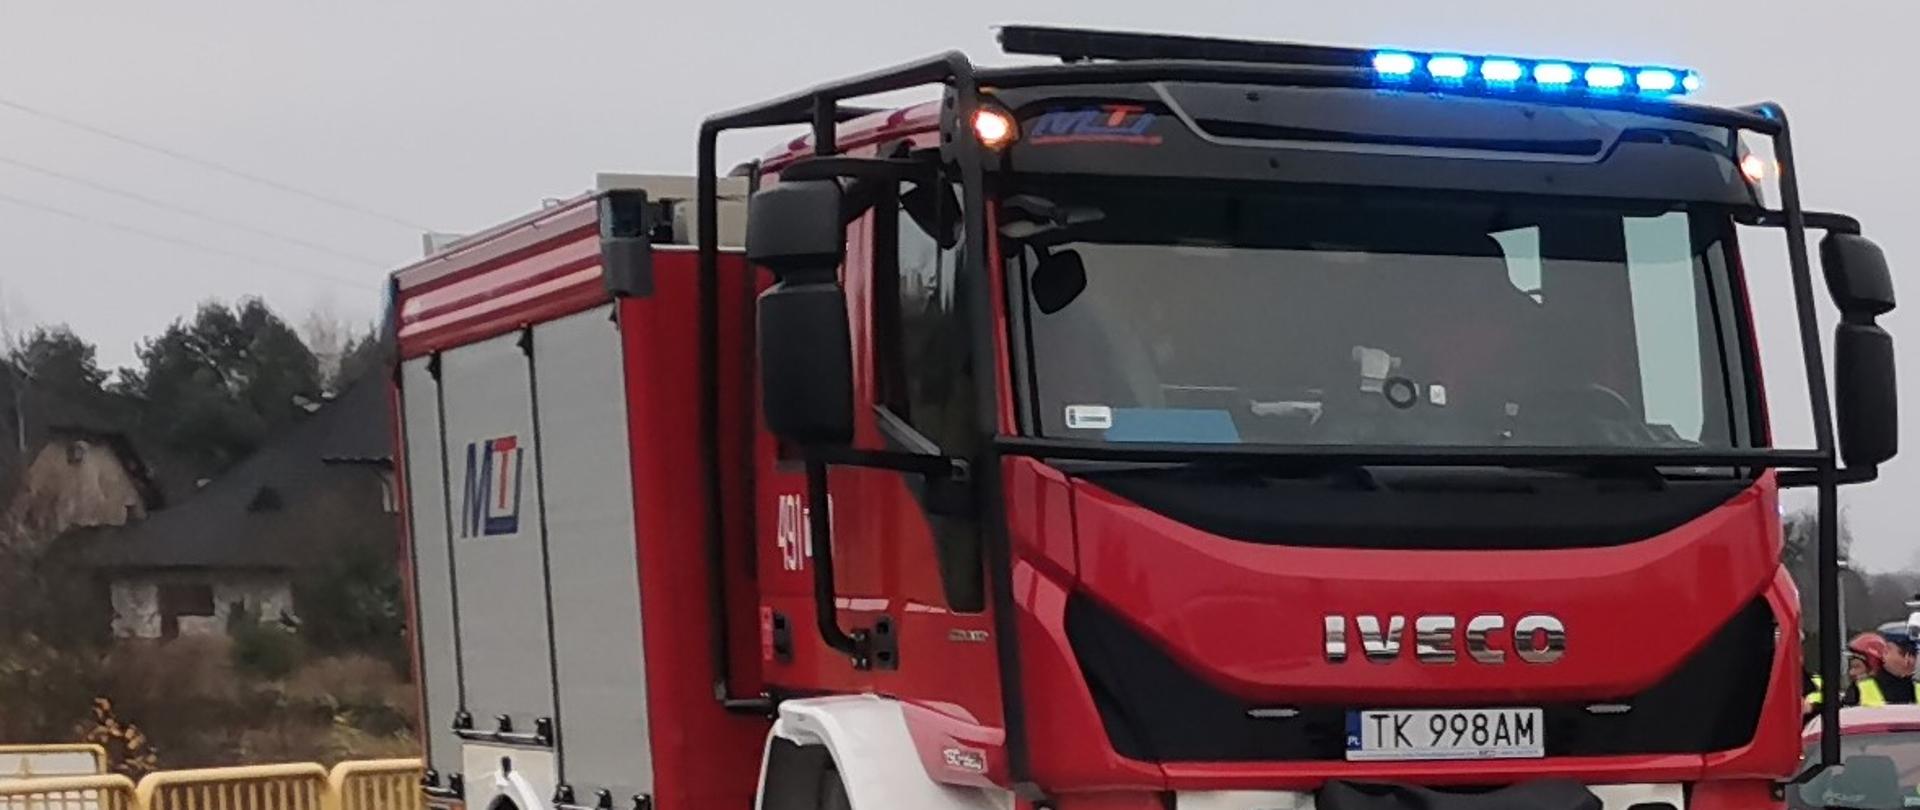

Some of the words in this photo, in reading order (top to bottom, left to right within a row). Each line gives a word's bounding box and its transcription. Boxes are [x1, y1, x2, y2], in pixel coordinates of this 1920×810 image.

[1324, 614, 1567, 664] IVECO
[1347, 736, 1361, 746] PL
[1370, 714, 1414, 748] TK
[1429, 713, 1535, 747] 998AM
